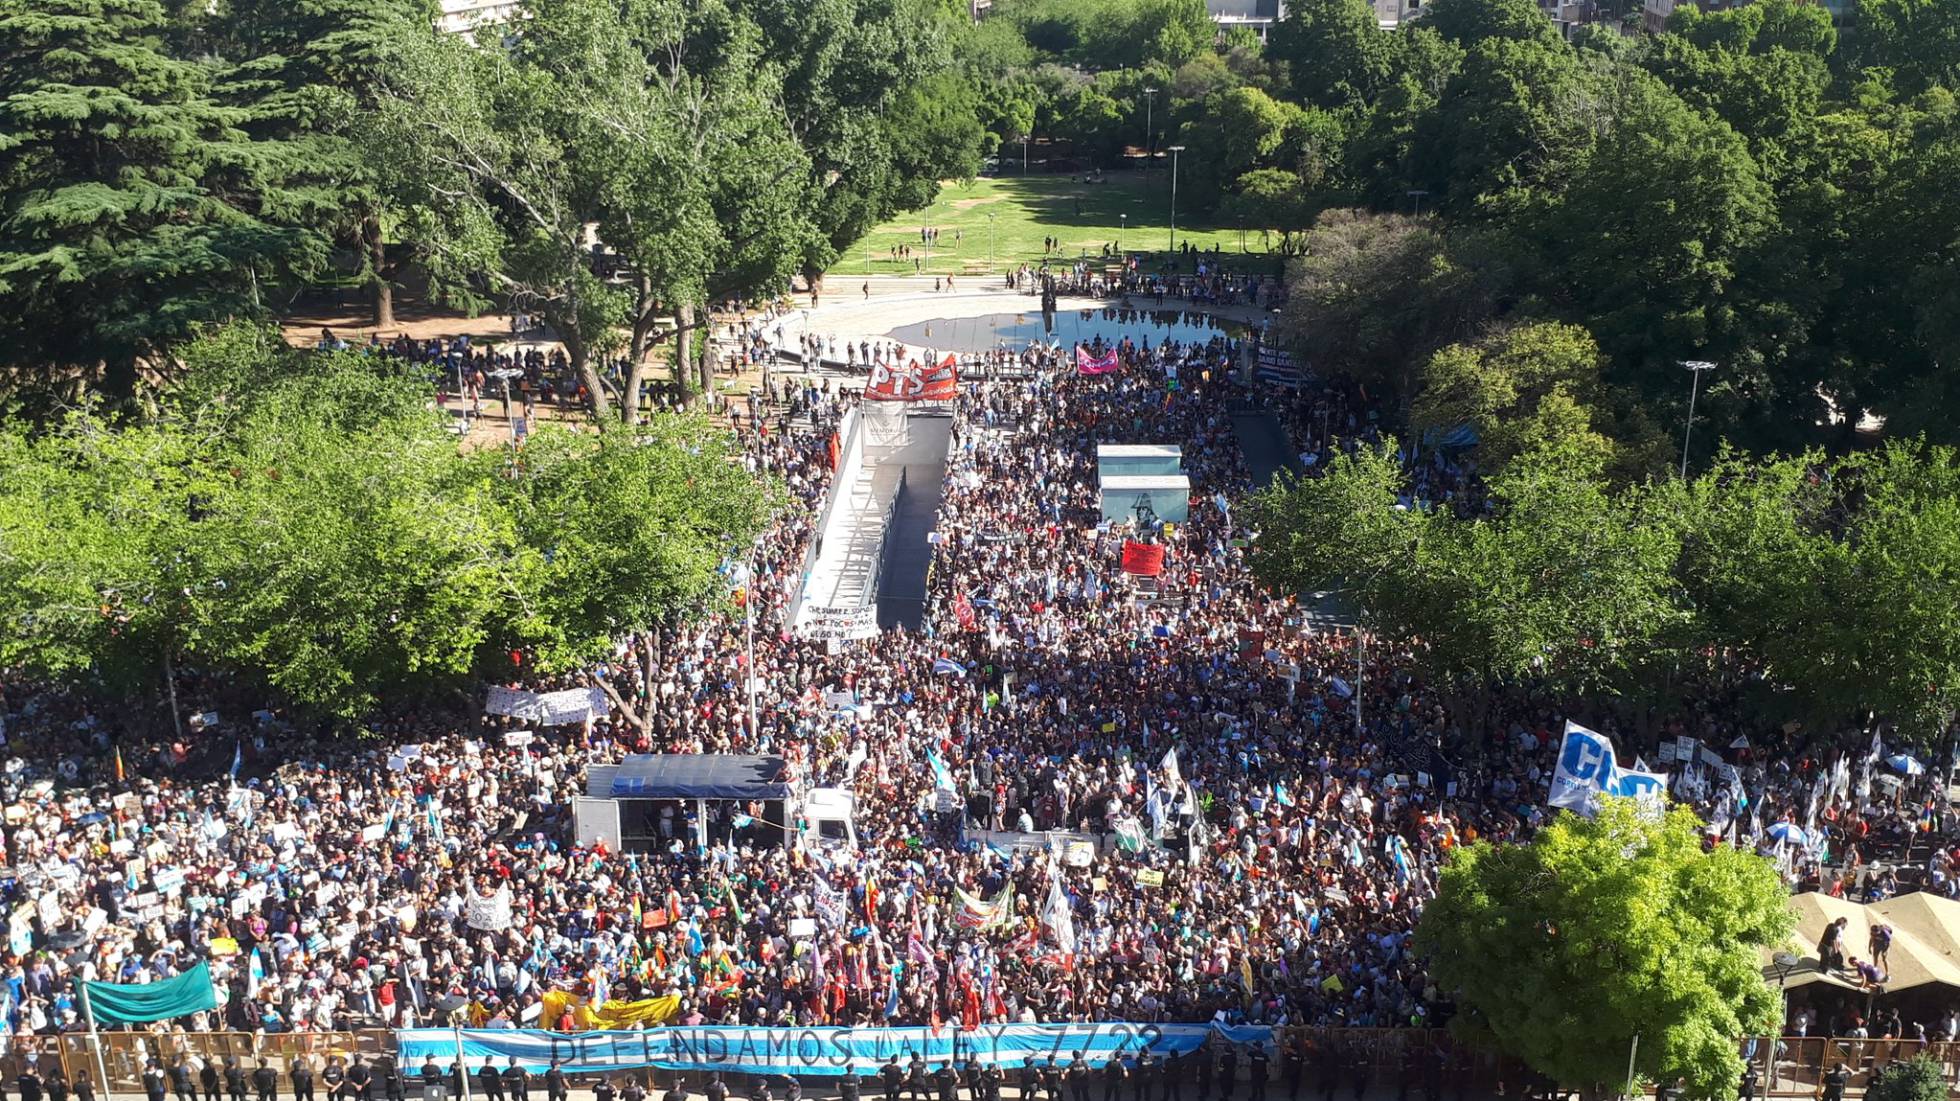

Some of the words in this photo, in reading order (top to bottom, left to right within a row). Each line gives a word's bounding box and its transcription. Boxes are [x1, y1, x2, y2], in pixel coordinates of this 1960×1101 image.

[869, 360, 925, 397] PTS
[550, 1028, 853, 1067] DEFENDAMOS
[1043, 1023, 1163, 1060] 7722
